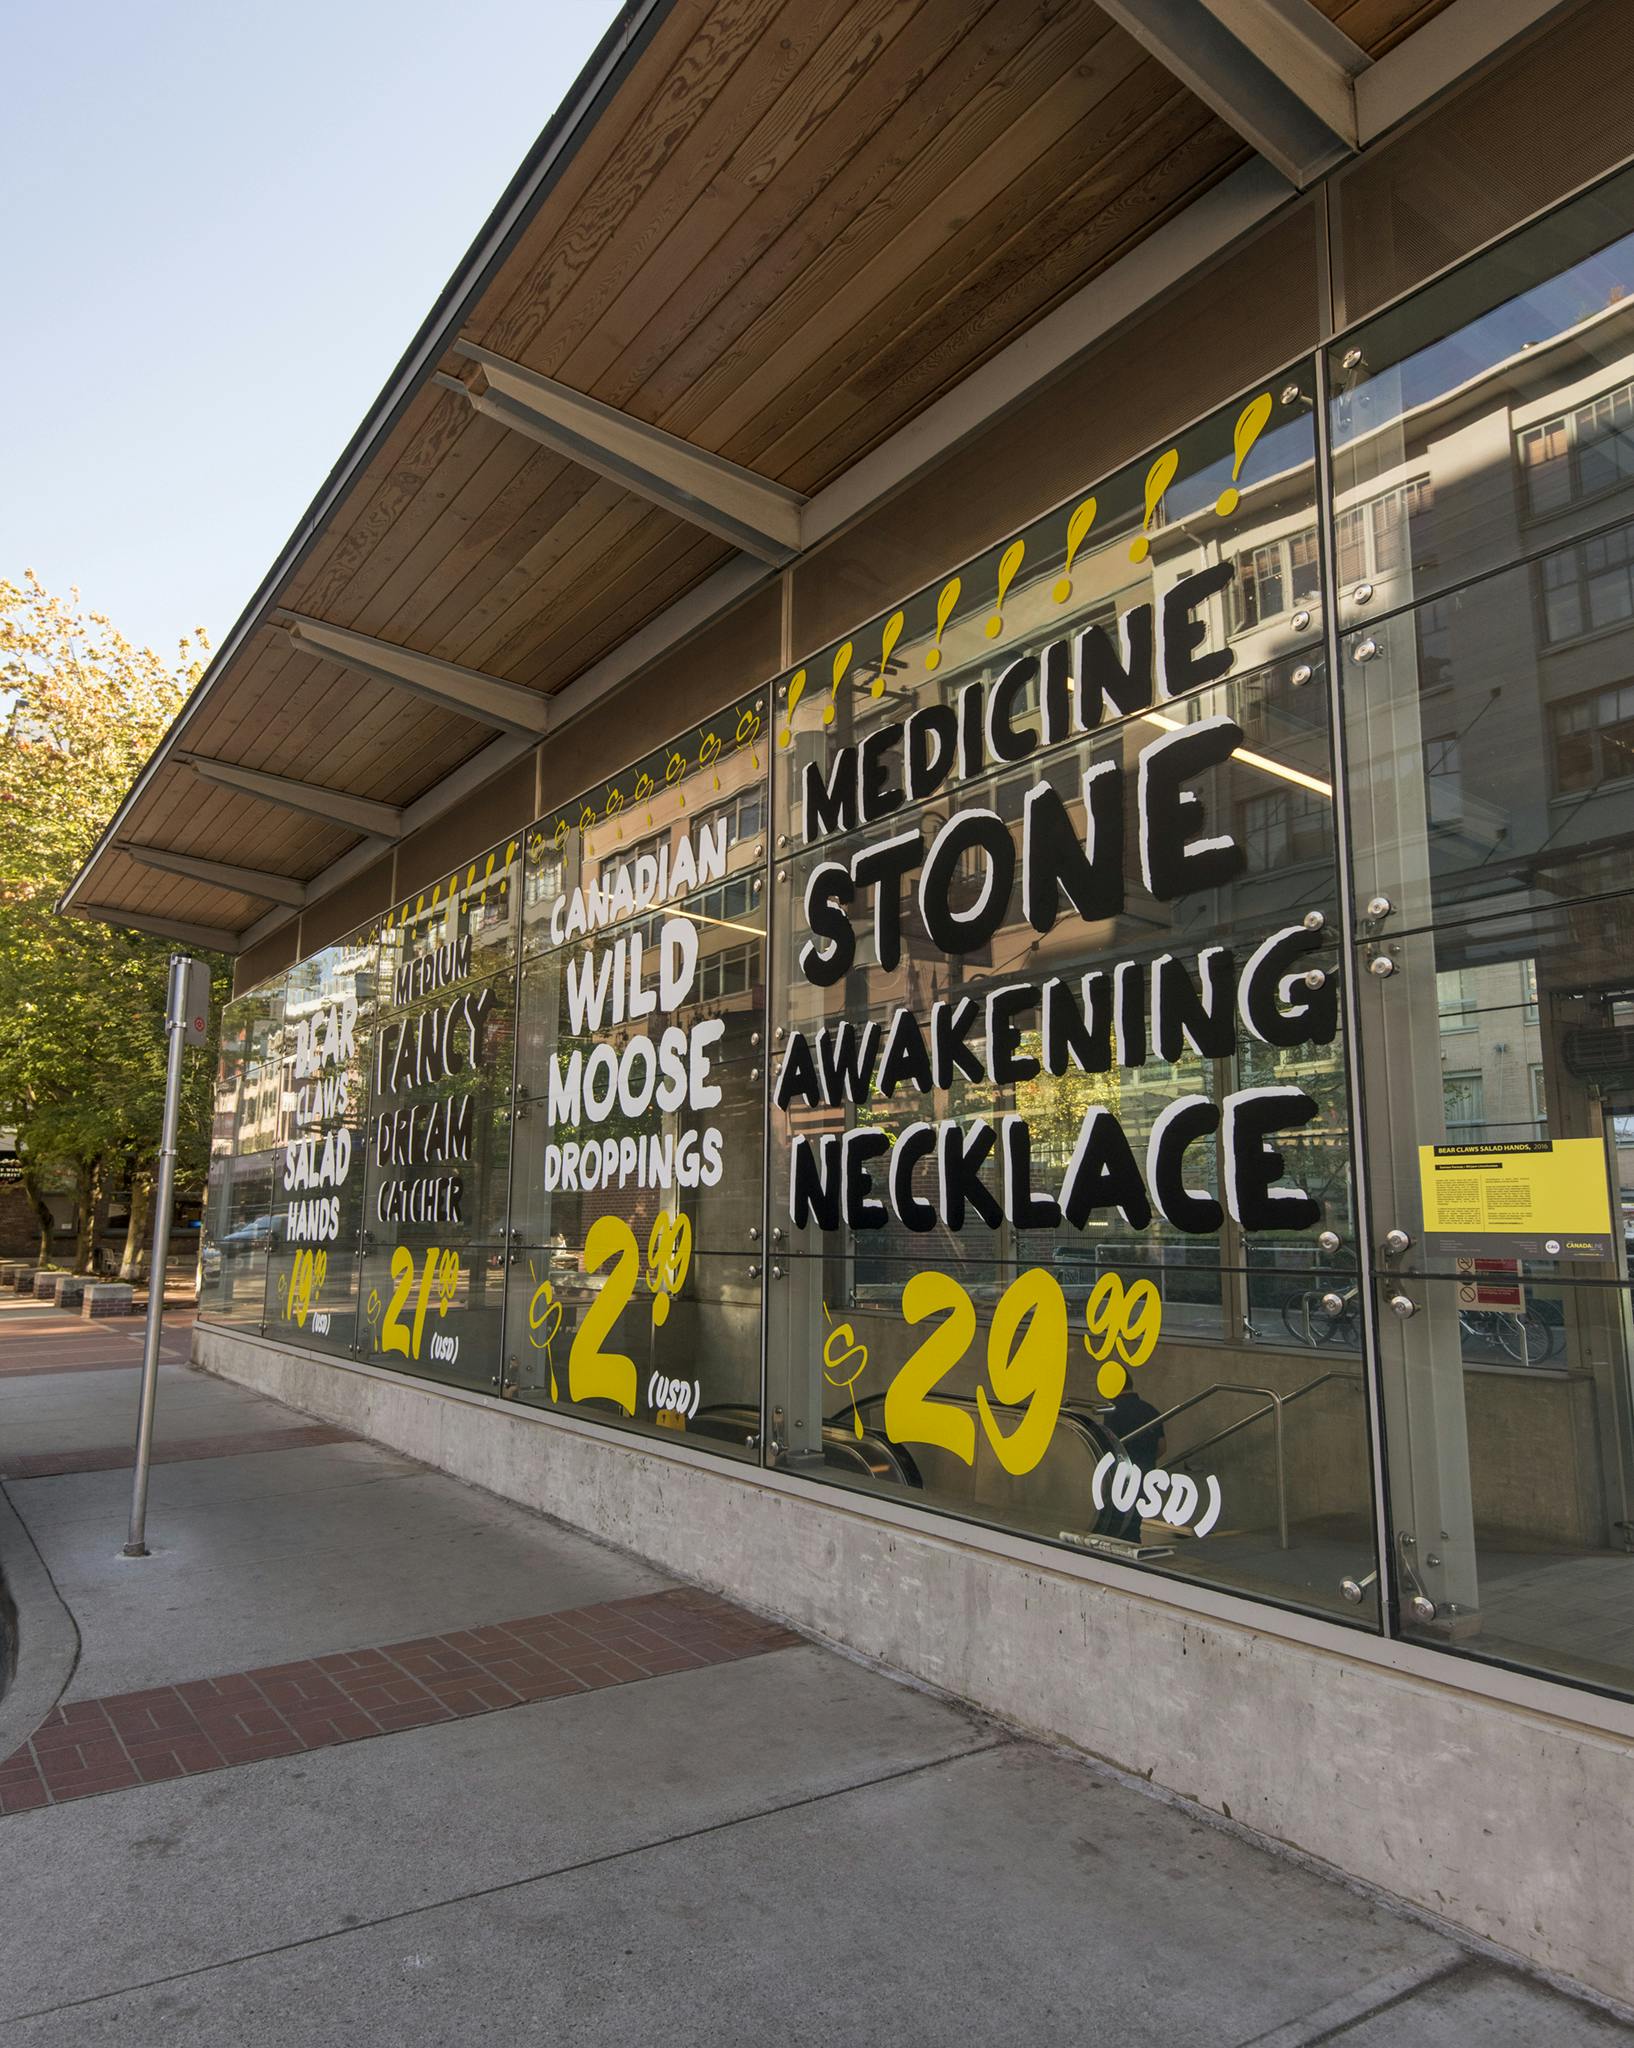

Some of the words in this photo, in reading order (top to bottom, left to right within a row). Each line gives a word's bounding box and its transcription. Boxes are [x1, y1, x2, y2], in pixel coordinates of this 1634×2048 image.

[802, 562, 1235, 845] MEDICINE
[551, 816, 729, 945] CANADIAN
[800, 715, 1244, 987] STONE
[394, 934, 472, 1008] MEDIUM
[566, 917, 699, 1036] WILD
[296, 996, 358, 1080] BEAR
[377, 988, 498, 1096] FANCY
[774, 926, 1338, 1111] AWAKENING
[296, 1071, 351, 1127] CLAWS
[547, 1018, 725, 1128] MOOSE
[283, 1127, 352, 1191] SALAD
[376, 1094, 474, 1168] DREAM
[544, 1126, 724, 1191] DROPPINGS
[790, 1086, 1321, 1234] NECKLACE
[287, 1196, 340, 1242] HANDS
[377, 1176, 465, 1223] CATCHER
[311, 1312, 331, 1336] (USD)
[430, 1332, 459, 1365] (USD)
[648, 1370, 700, 1420] (USD)
[1092, 1451, 1221, 1538] (USD)
